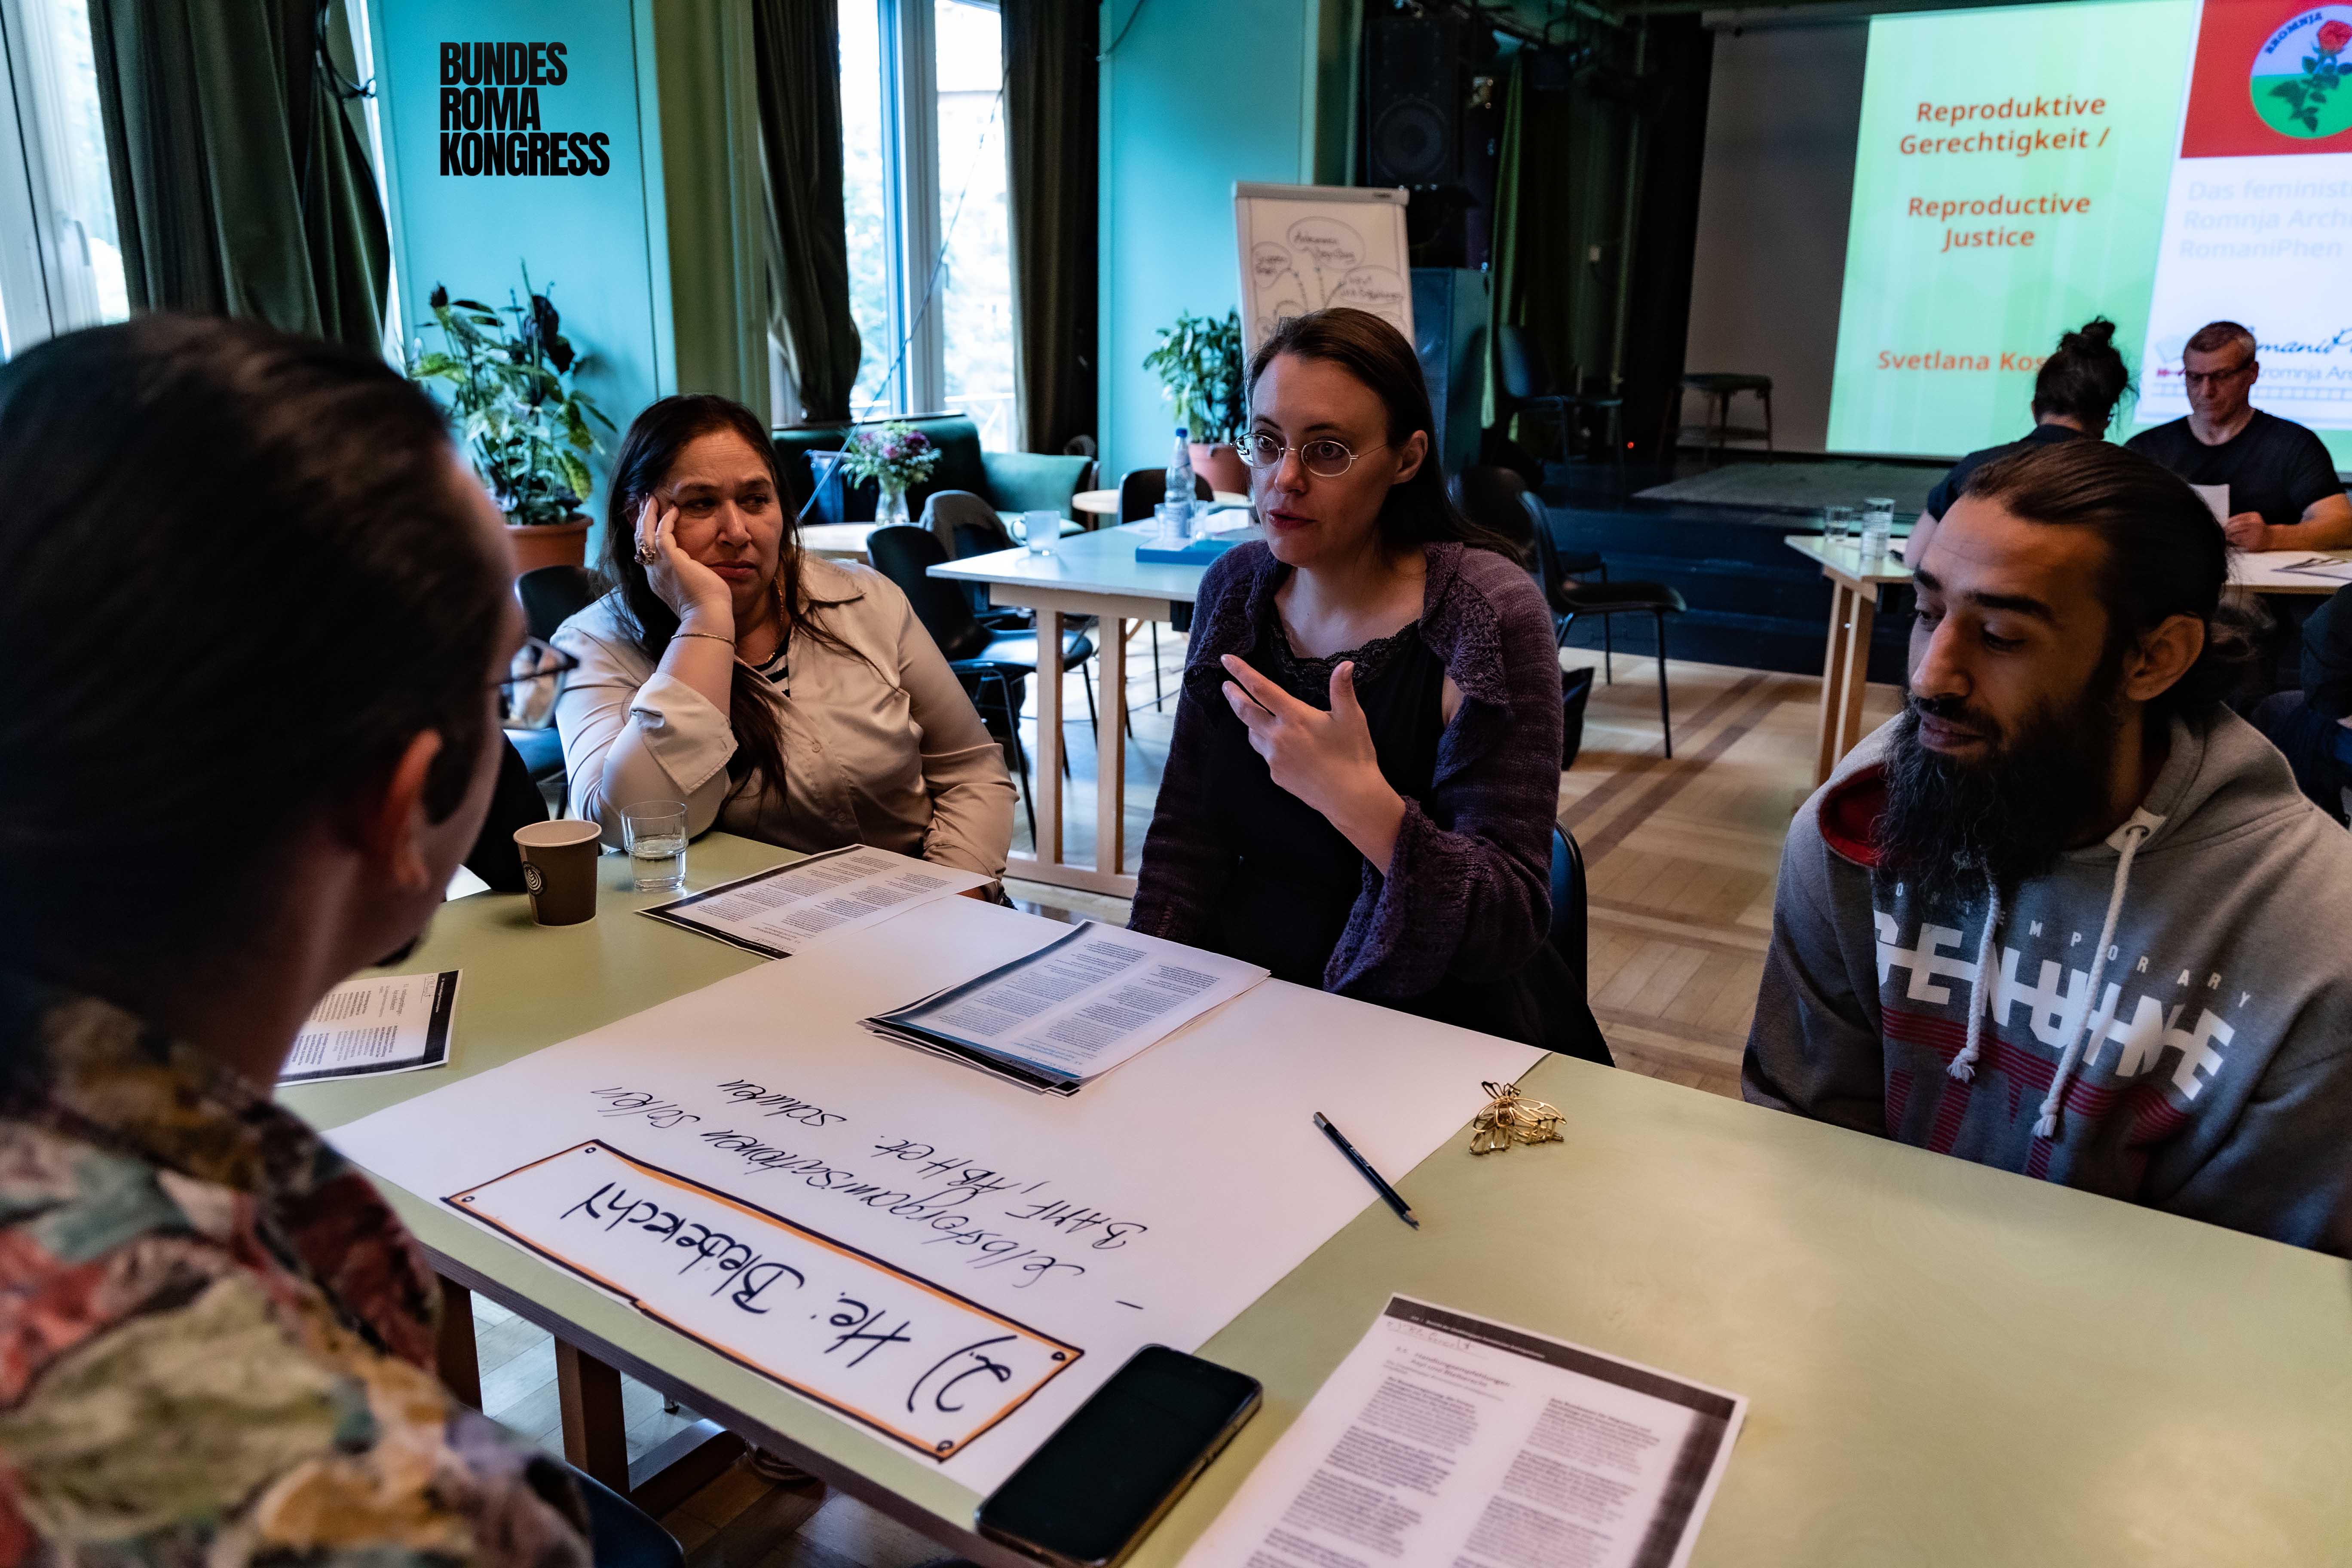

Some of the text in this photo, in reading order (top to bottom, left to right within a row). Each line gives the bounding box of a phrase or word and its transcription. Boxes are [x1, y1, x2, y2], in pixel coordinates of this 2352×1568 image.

[1917, 95, 2106, 127] Reproduktive
[1900, 129, 2089, 156] Gerechtigkeit
[2187, 181, 2235, 200] Das
[1908, 194, 2091, 221] Reproductive
[2184, 208, 2280, 233] Romnja
[1942, 229, 2036, 253] Justice
[1878, 350, 1990, 371] Svetlana
[590, 1086, 701, 1129] sollen
[559, 1181, 806, 1315] Bleiberecht
